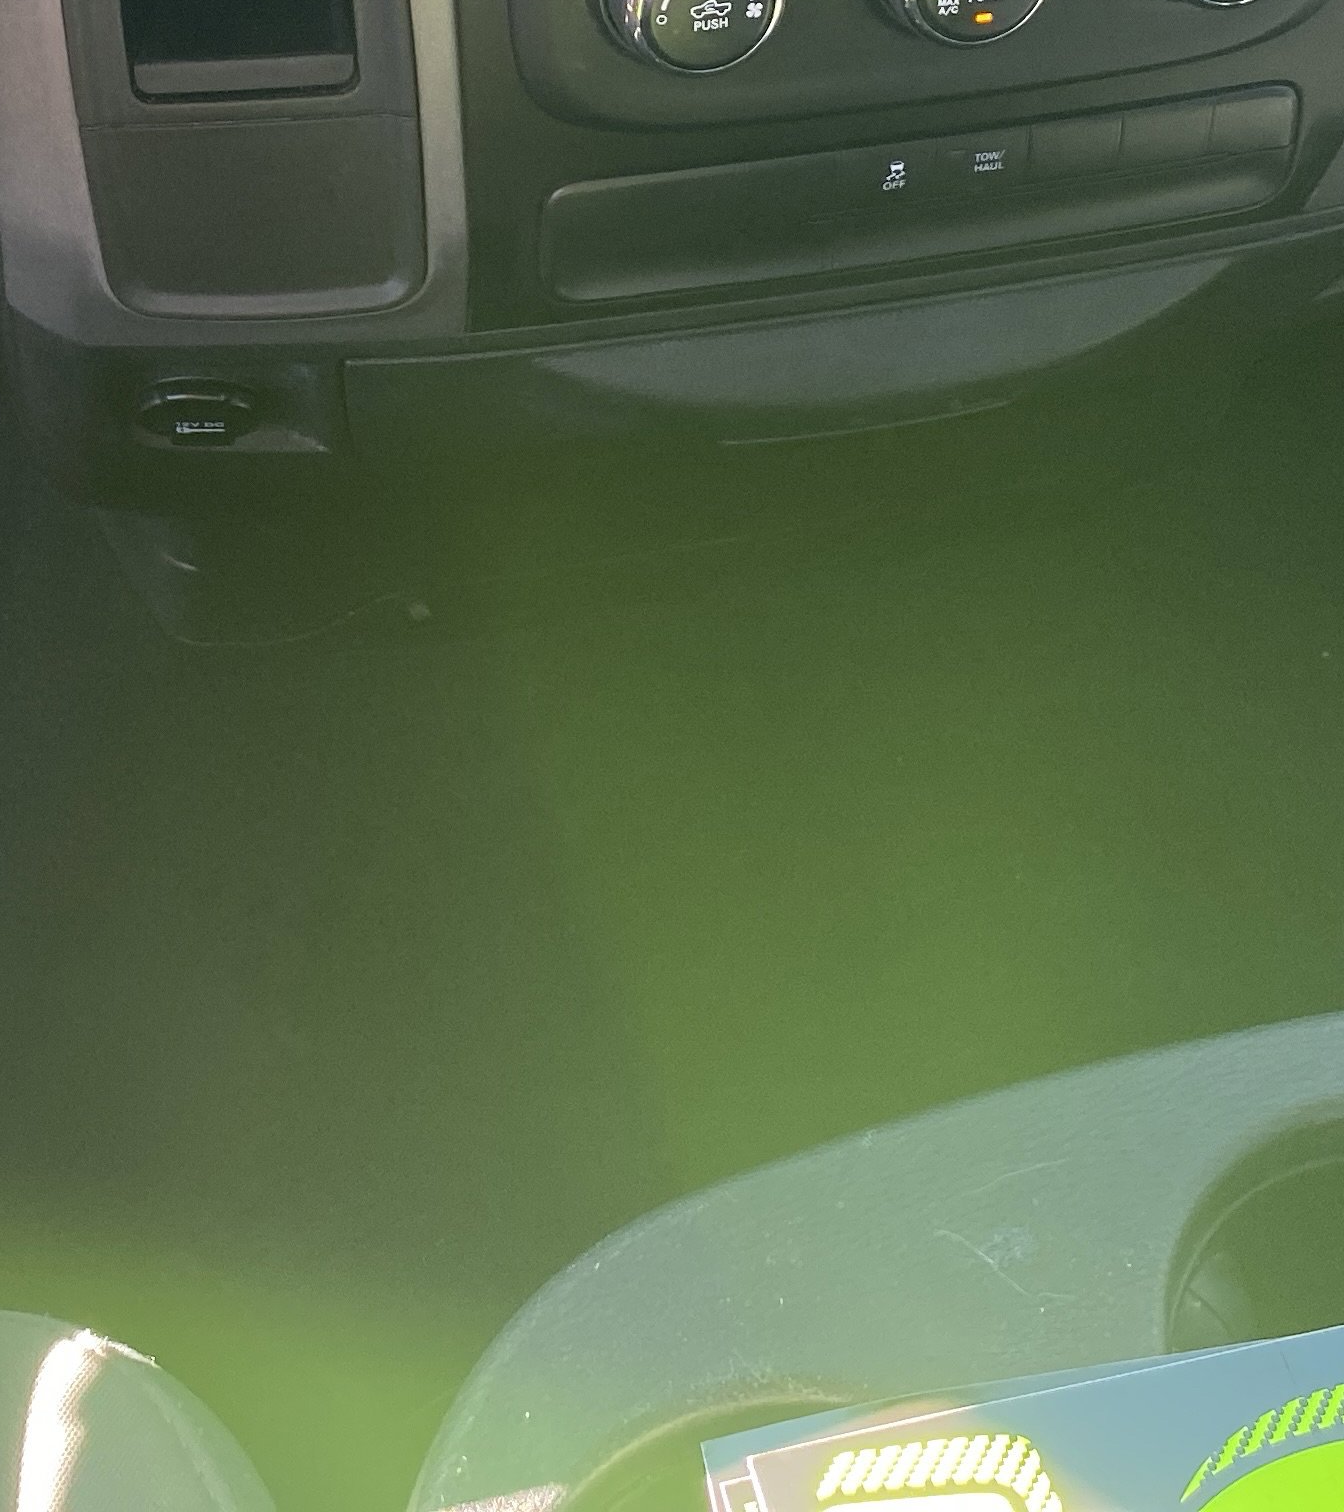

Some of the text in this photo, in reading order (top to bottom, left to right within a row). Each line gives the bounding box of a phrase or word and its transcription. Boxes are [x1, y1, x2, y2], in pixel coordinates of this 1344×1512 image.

[938, 5, 959, 16] A/C
[693, 16, 729, 32] PUSH
[974, 161, 1004, 173] HAUL
[882, 179, 907, 191] OFF
